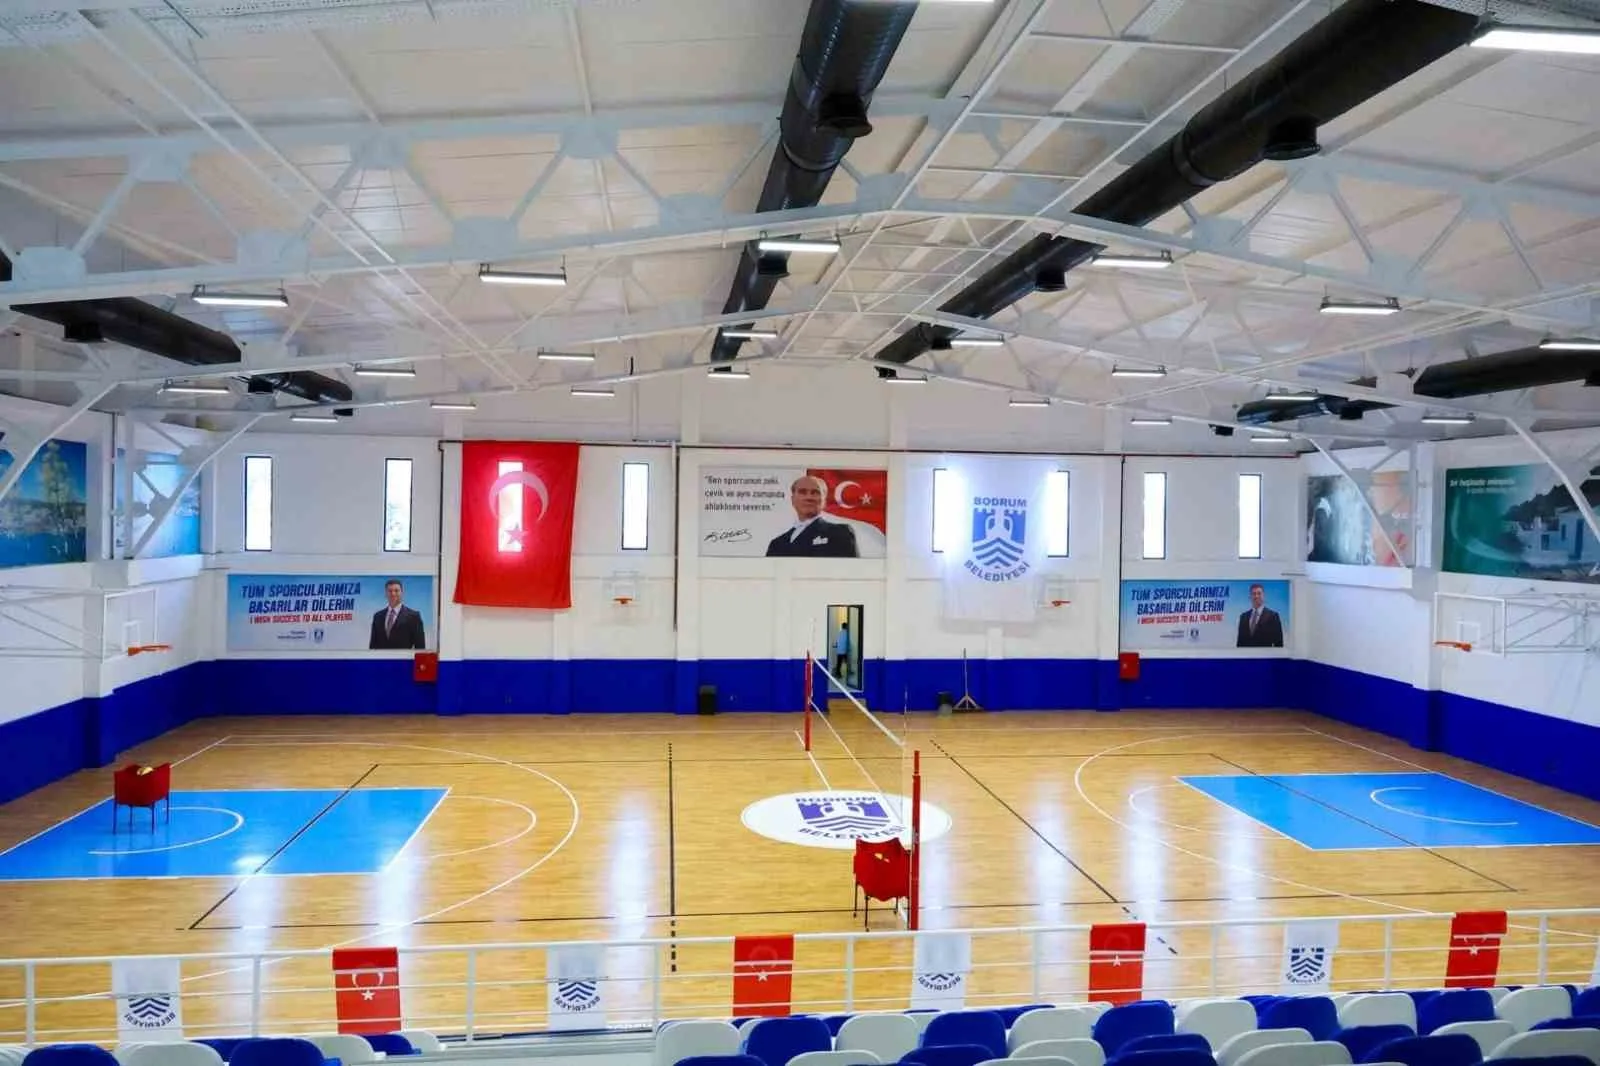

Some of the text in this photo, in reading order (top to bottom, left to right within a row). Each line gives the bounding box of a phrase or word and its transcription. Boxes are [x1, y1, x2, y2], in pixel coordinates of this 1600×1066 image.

[752, 490, 785, 499] zamanda
[973, 496, 1027, 507] BODRUM
[268, 581, 361, 598] SPORCULARIMIZA
[1153, 584, 1230, 600] SPORCULARIMIZA
